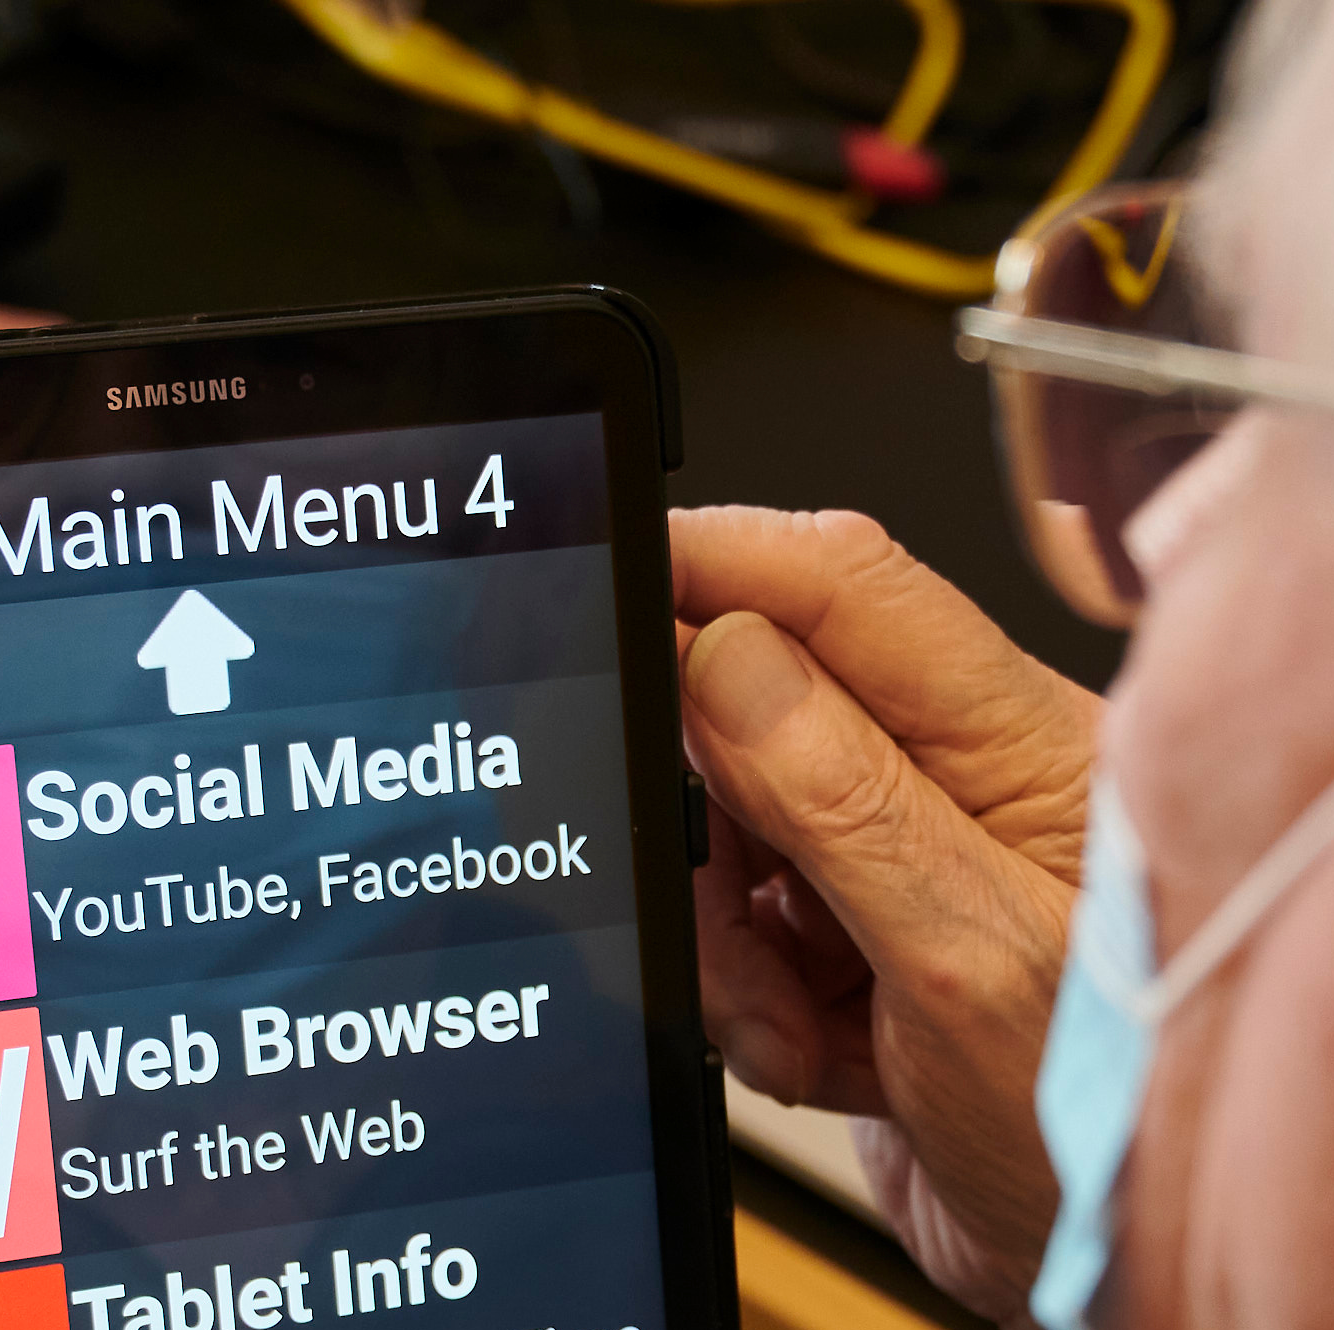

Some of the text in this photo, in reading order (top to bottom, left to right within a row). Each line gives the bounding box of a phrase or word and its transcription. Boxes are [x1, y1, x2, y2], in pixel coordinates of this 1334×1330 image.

[105, 375, 248, 412] SAMSUNG
[210, 473, 440, 557] Menu
[463, 453, 516, 530] 4
[25, 720, 523, 842] Social Media
[30, 822, 593, 942] YouTube, Facebook
[45, 983, 551, 1103] Web Browser
[60, 1098, 426, 1201] Surf the Web
[331, 1232, 479, 1318] Info
